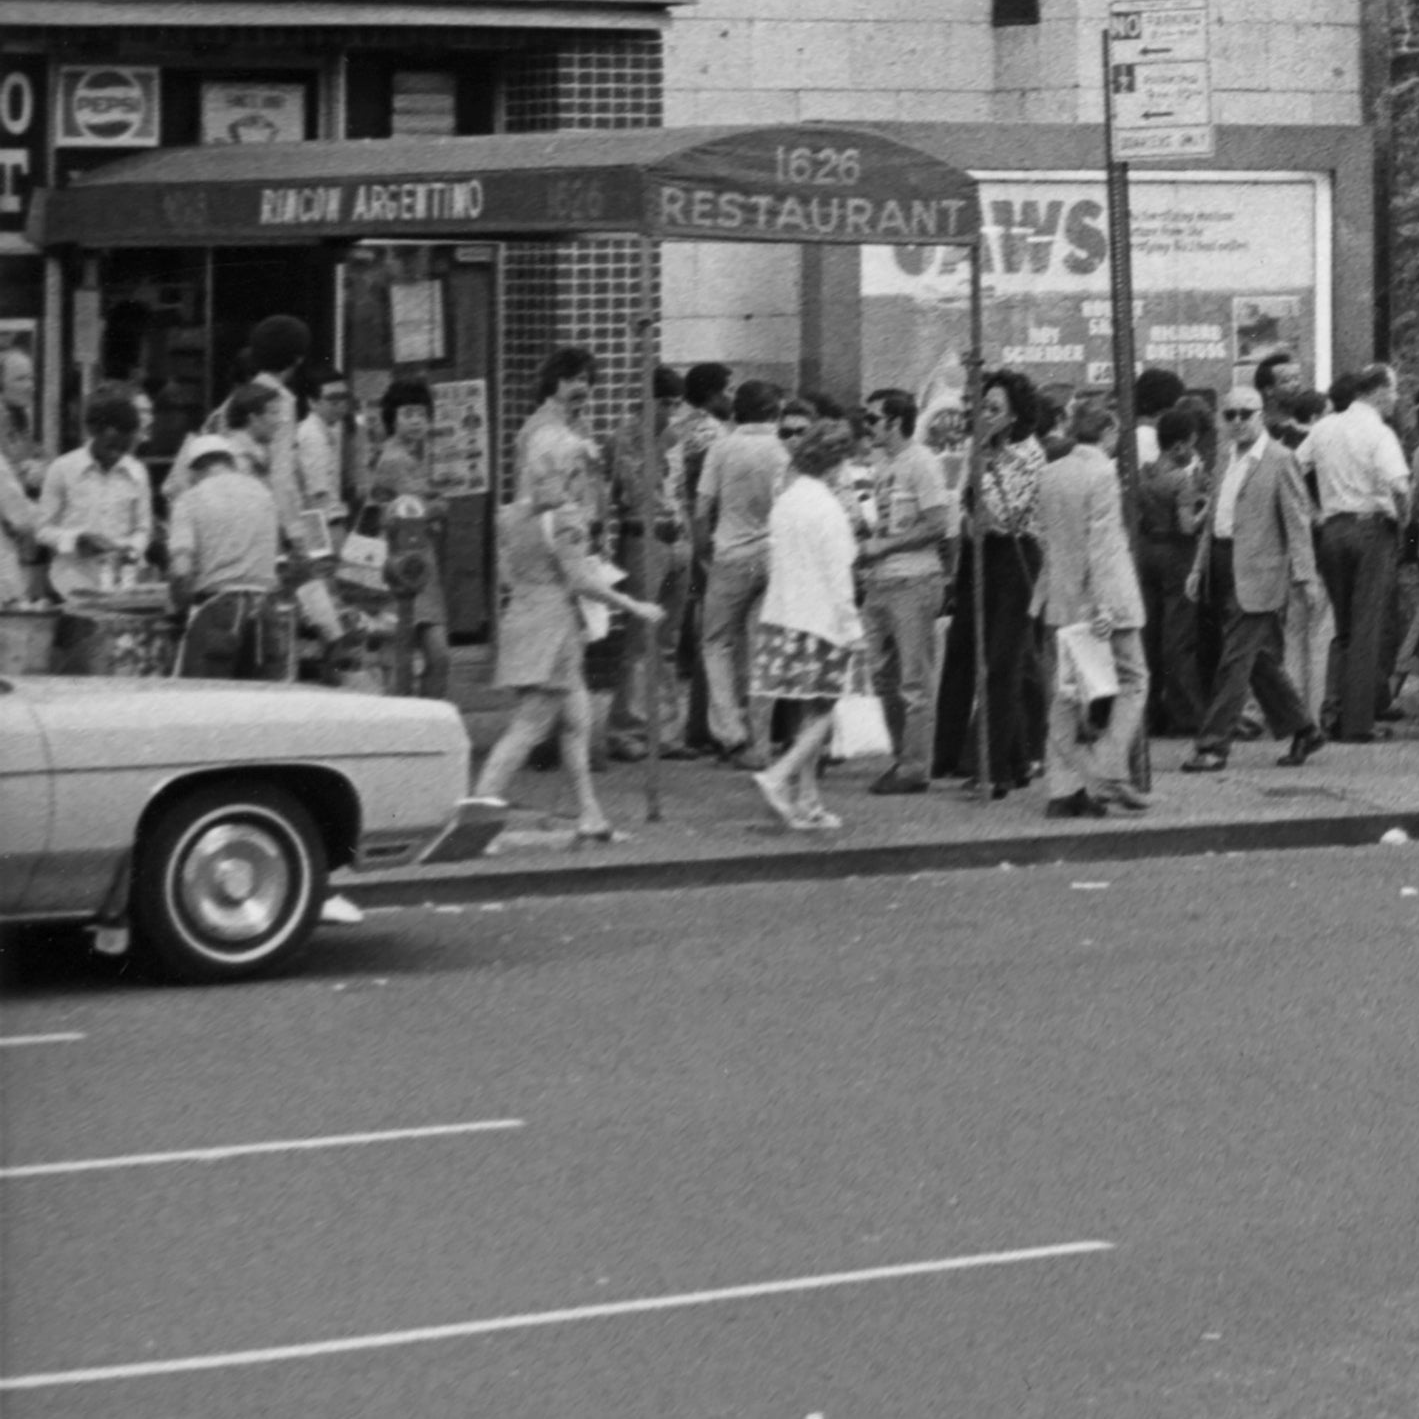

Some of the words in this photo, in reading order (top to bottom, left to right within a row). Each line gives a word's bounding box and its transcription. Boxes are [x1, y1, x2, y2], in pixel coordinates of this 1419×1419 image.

[775, 145, 861, 186] 1626
[259, 186, 343, 225] RINCON
[351, 179, 484, 222] ARGENTINO
[660, 186, 967, 236] RESTAURANT
